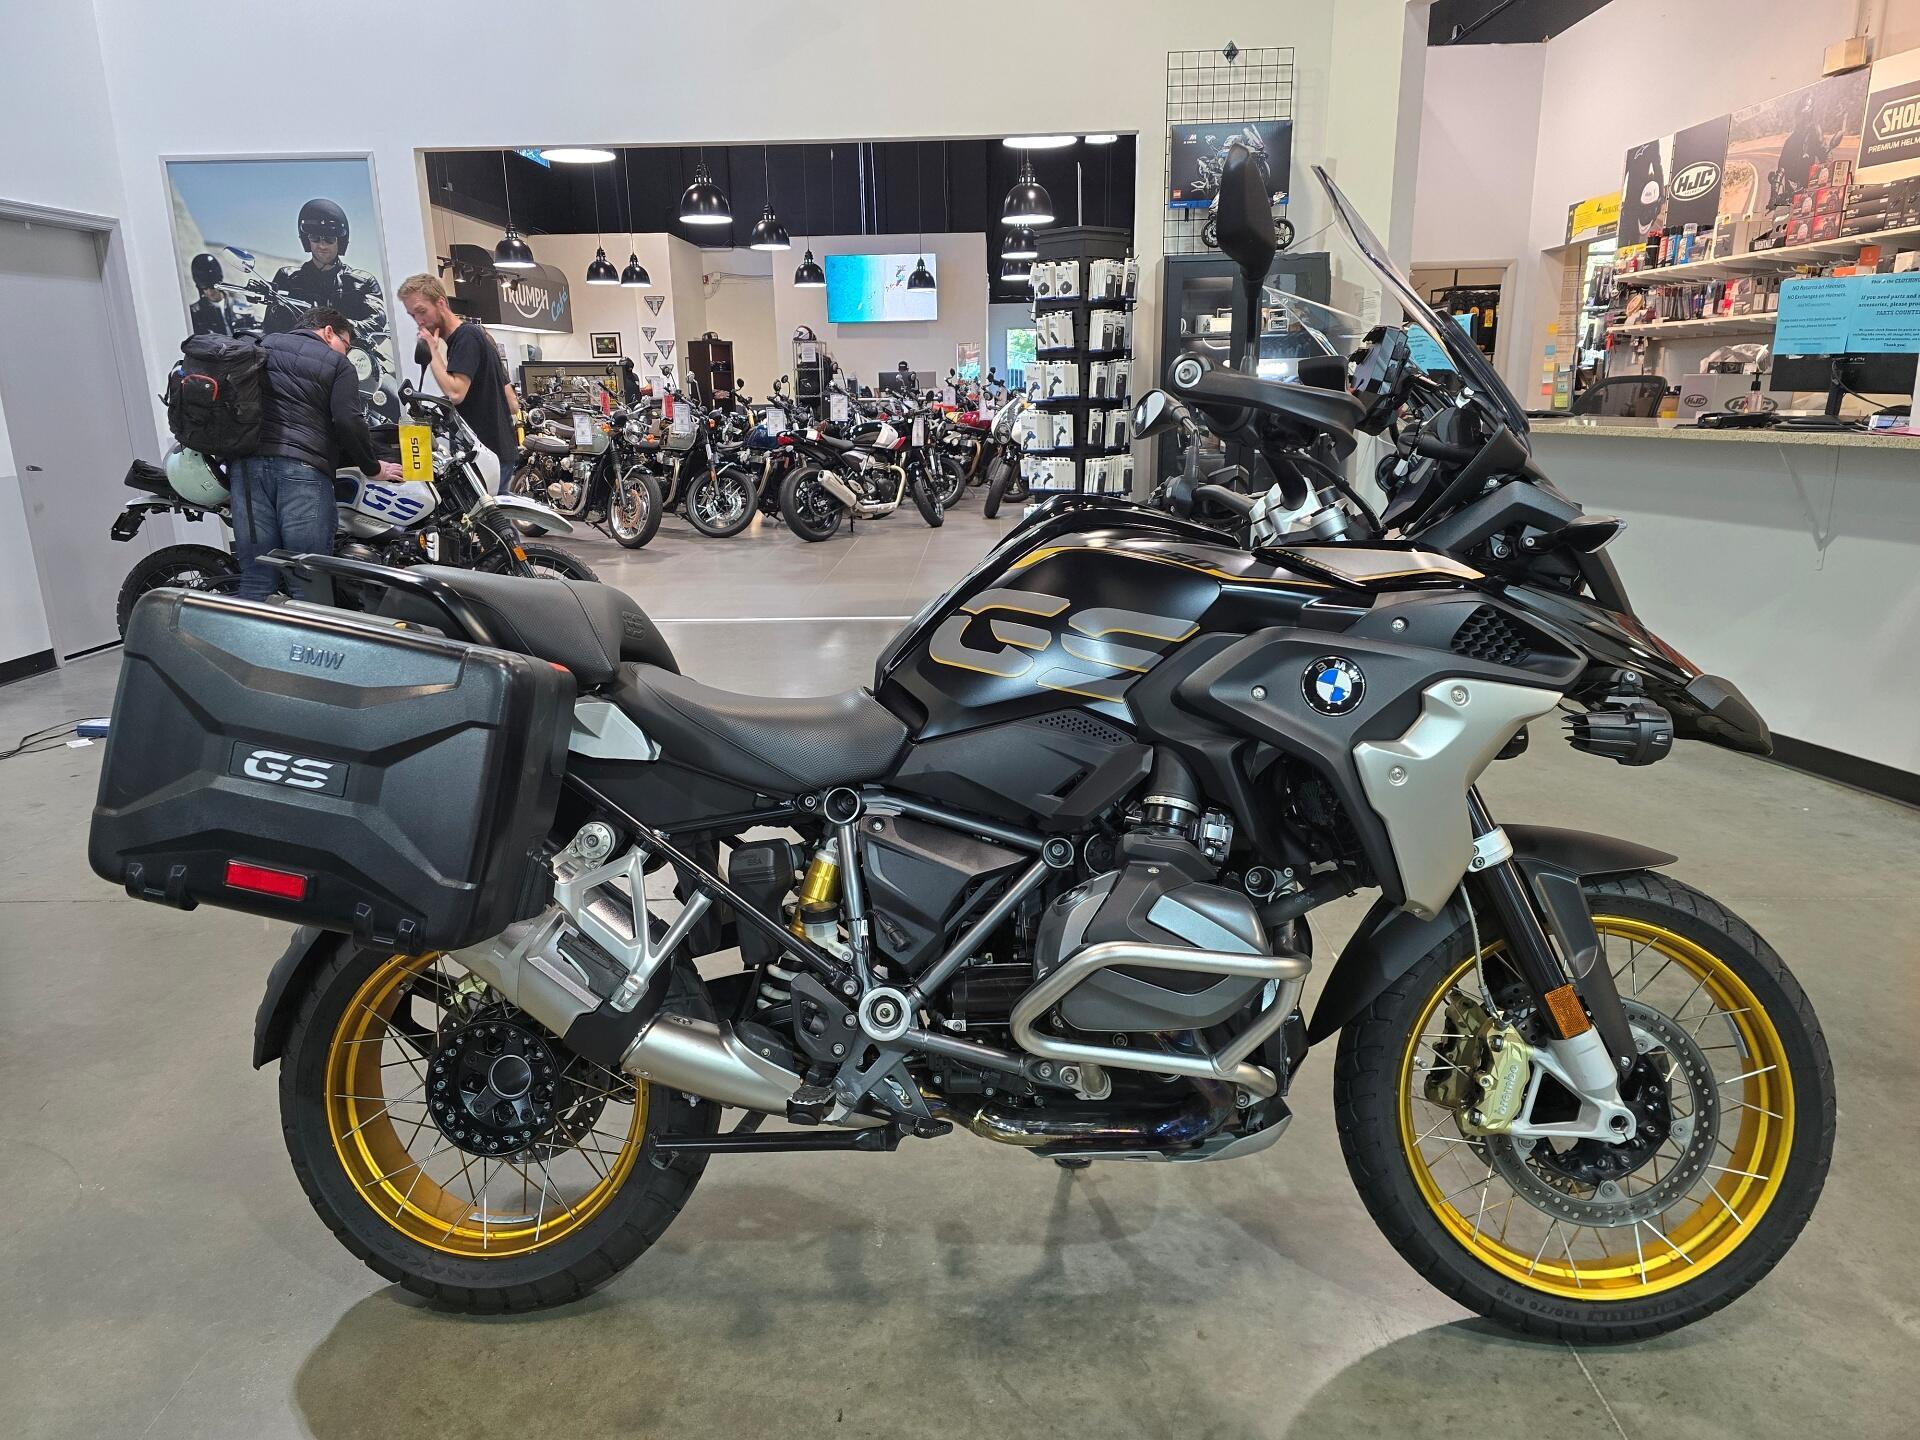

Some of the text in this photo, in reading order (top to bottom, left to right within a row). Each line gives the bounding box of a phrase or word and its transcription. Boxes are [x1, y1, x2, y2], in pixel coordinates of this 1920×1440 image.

[1881, 101, 1920, 134] SHOE
[1868, 136, 1920, 154] PREMIUM HELM
[1676, 168, 1713, 194] HJC
[411, 437, 421, 470] SOLD
[362, 484, 424, 520] GS
[289, 643, 345, 670] BMW
[929, 588, 1201, 704] GS
[1315, 660, 1361, 683] BMW
[244, 750, 335, 789] GS
[1494, 1064, 1519, 1115] brembo
[1588, 1300, 1677, 1322] MICHELIN
